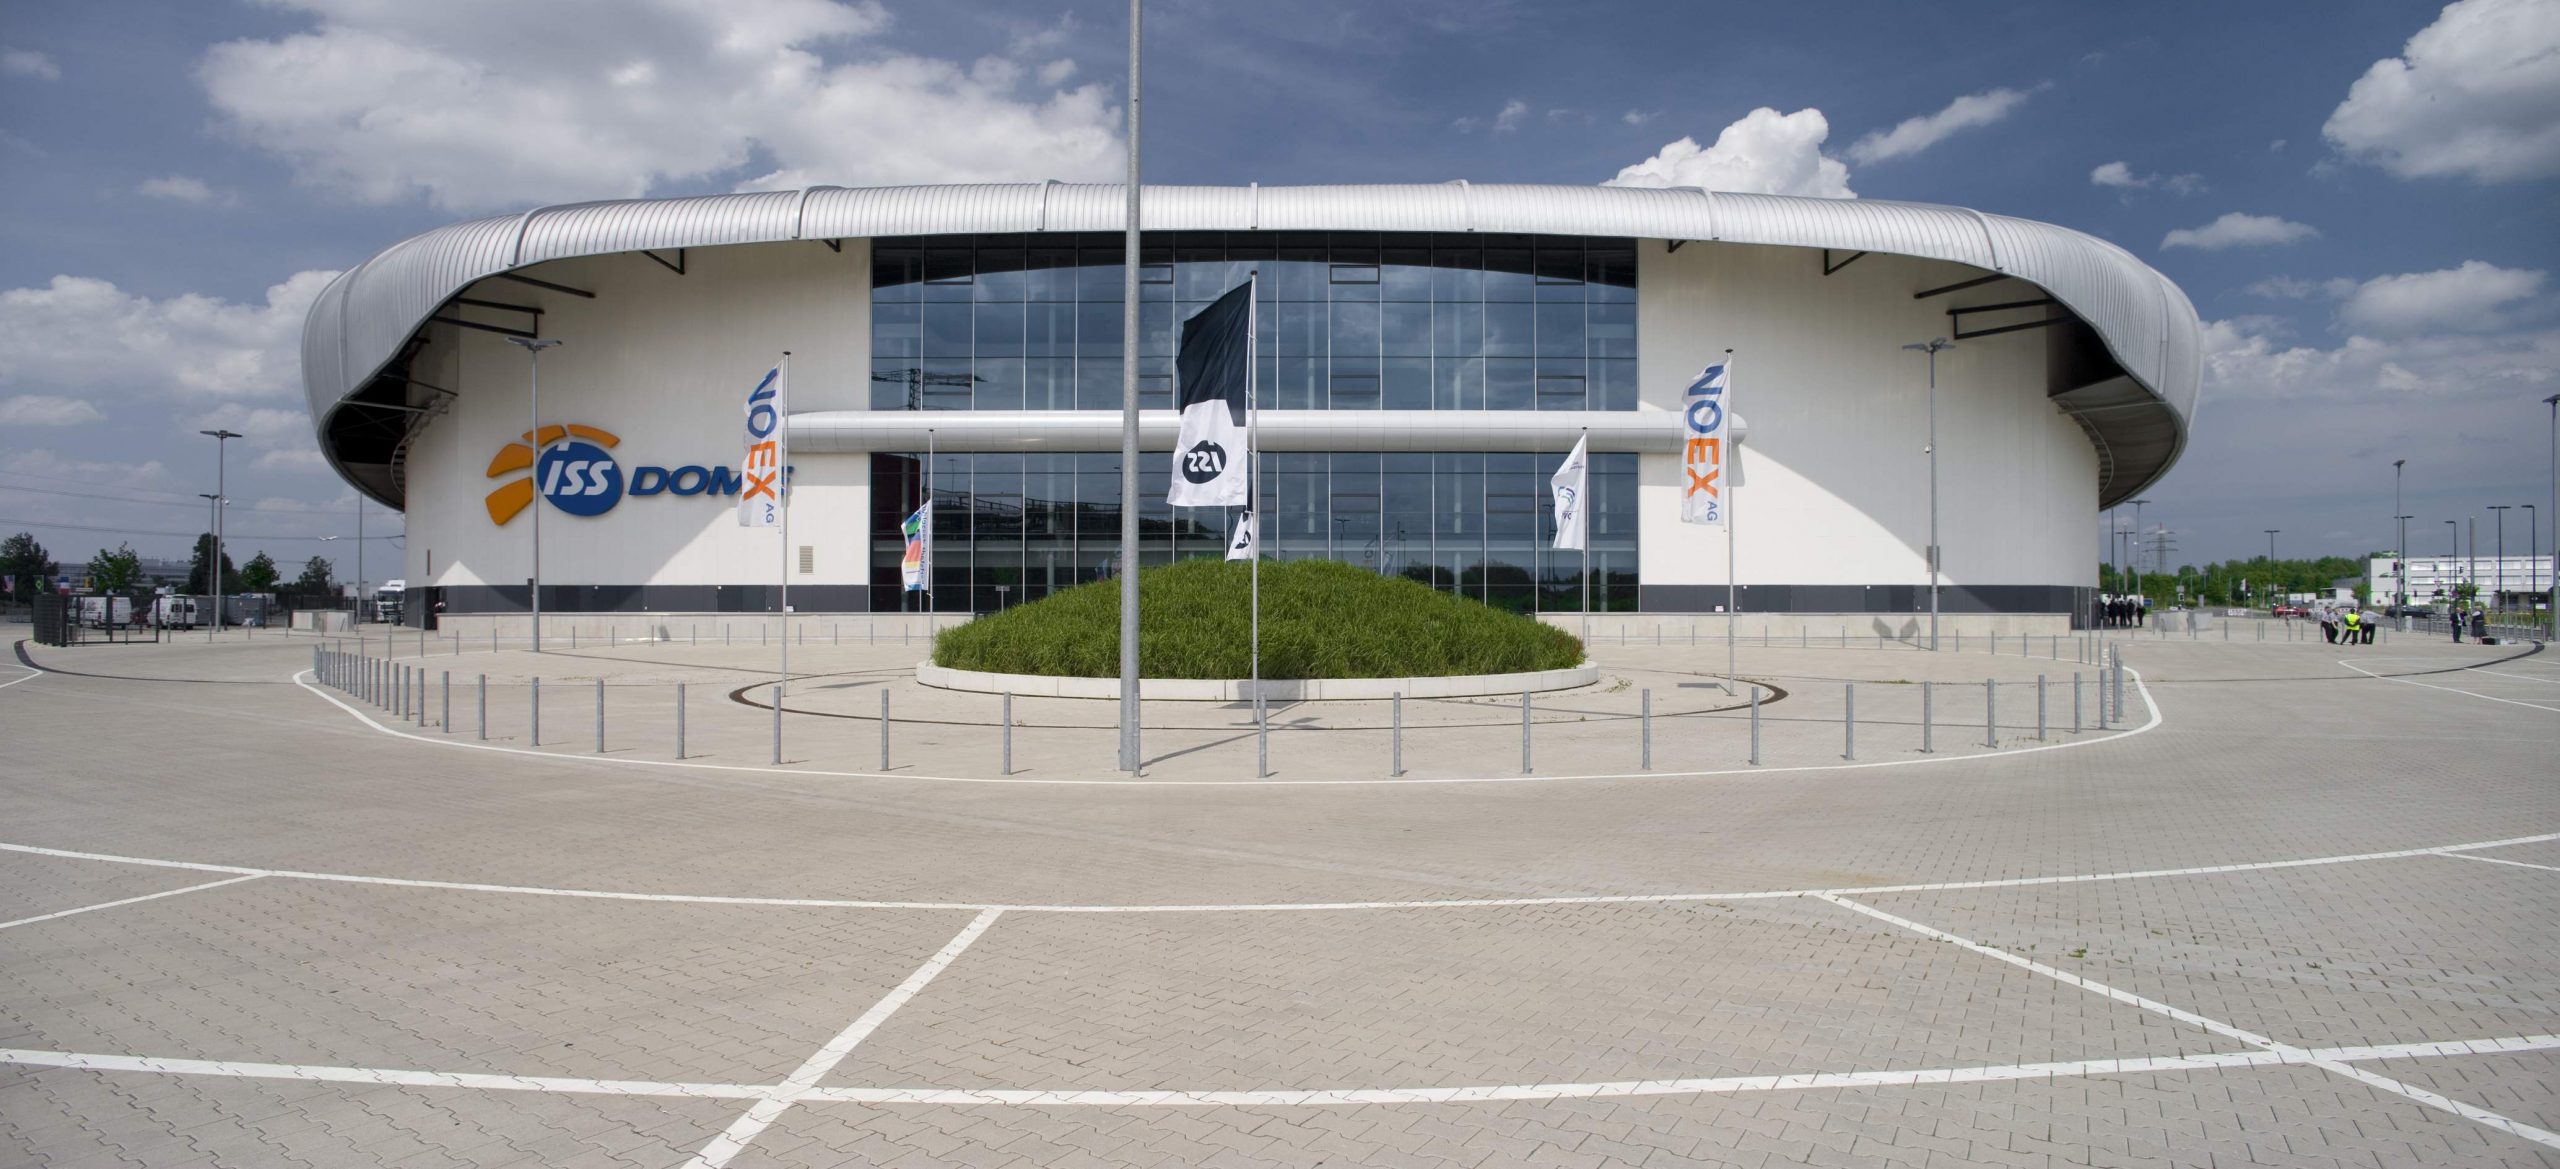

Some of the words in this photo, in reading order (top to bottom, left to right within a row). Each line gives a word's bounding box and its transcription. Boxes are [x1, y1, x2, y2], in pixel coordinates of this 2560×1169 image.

[744, 368, 777, 500] NOEX
[765, 503, 775, 523] AG
[1688, 365, 1723, 498] NOEX
[1706, 501, 1718, 522] AG
